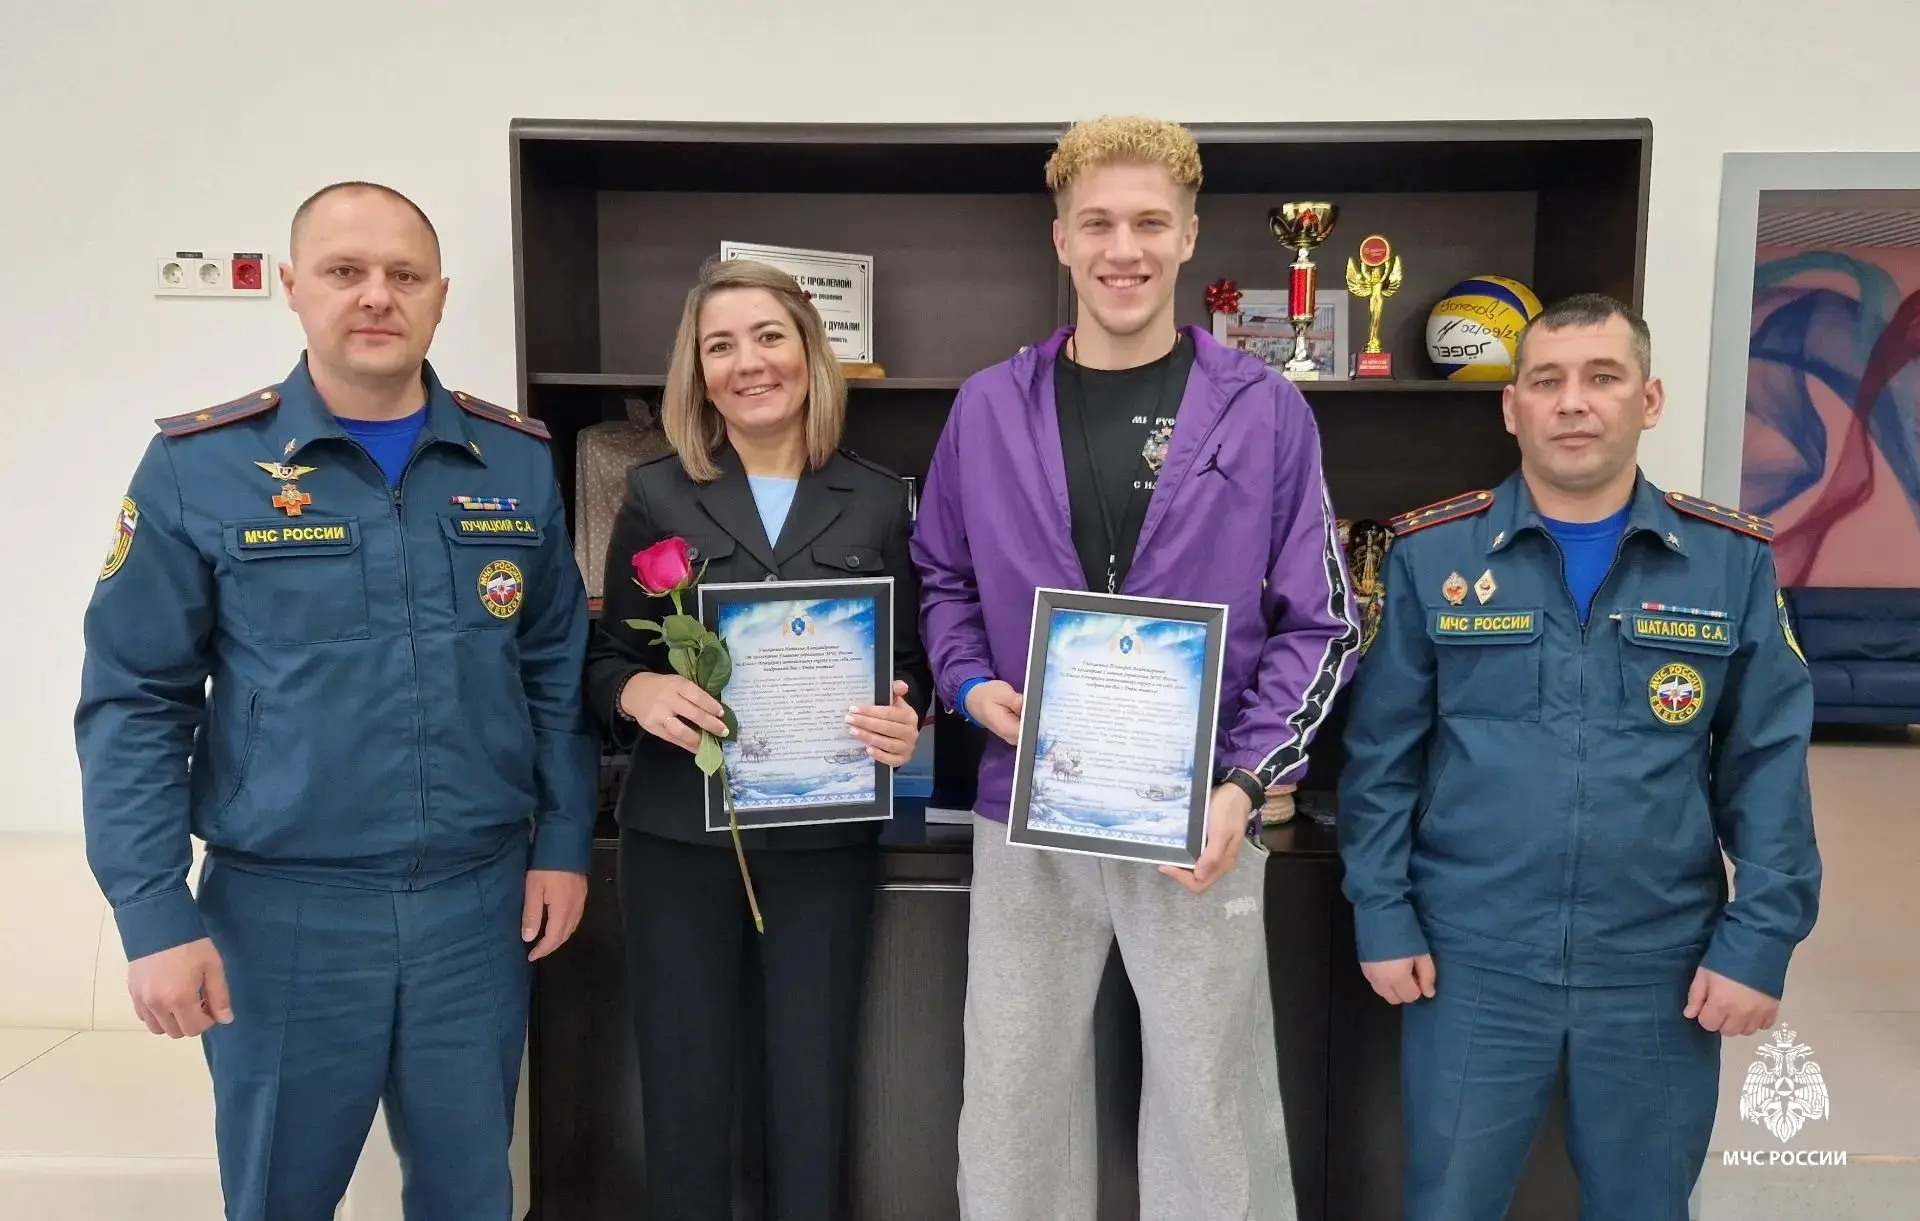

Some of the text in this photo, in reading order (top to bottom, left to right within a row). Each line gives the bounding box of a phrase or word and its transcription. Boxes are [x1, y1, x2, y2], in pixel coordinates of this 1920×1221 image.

[807, 277, 852, 288] ПРОБЛЕМОЙ!
[828, 321, 860, 331] ДУМАЛИ!
[1432, 341, 1492, 360] JÖGEL
[244, 526, 345, 543] МЧС РОССИИ
[460, 519, 535, 532] ЛУЧИЦКИЙ С.А.
[480, 561, 521, 586] МЧС РОССИИ
[481, 591, 522, 616] EMERCOM
[1440, 615, 1530, 631] МЧС РОССИИ
[1637, 619, 1728, 641] ШАТАЛОВ С.А.
[1650, 665, 1701, 691] МЧС РОССИИ
[1651, 696, 1700, 721] EMERCOM
